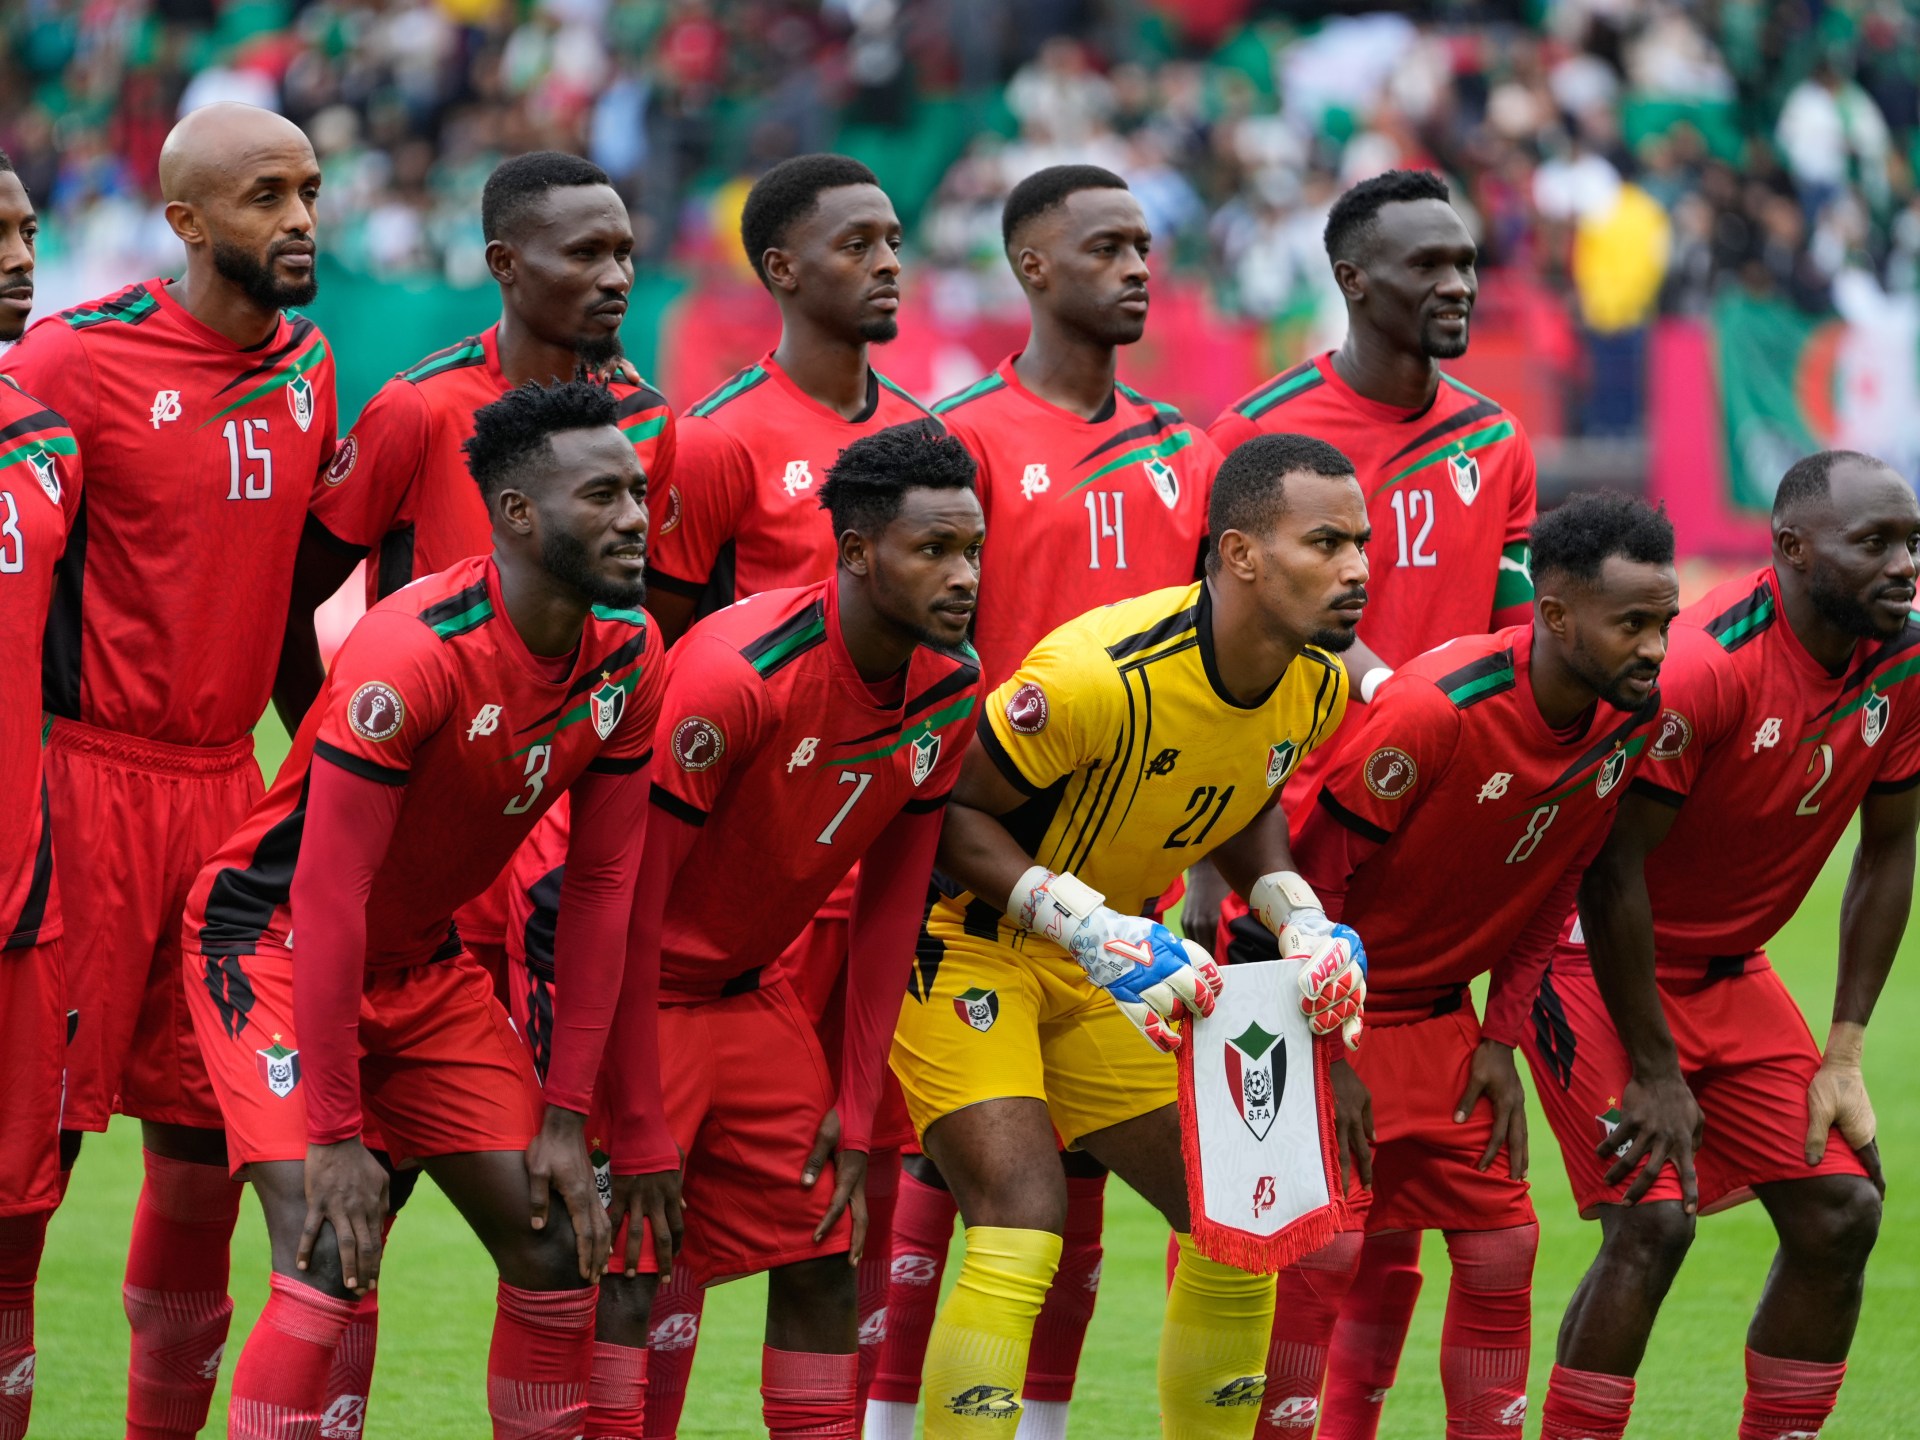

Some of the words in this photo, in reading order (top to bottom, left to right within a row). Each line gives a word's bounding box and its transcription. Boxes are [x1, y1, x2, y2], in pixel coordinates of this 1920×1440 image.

[222, 418, 273, 500] 15
[1084, 490, 1128, 569] 14
[1390, 489, 1438, 567] 12
[503, 745, 552, 815] 3
[816, 770, 873, 845] 7
[1795, 744, 1834, 816] 2
[1162, 785, 1236, 849] 21
[1505, 805, 1560, 864] 8
[1248, 1109, 1271, 1121] S.F.A
